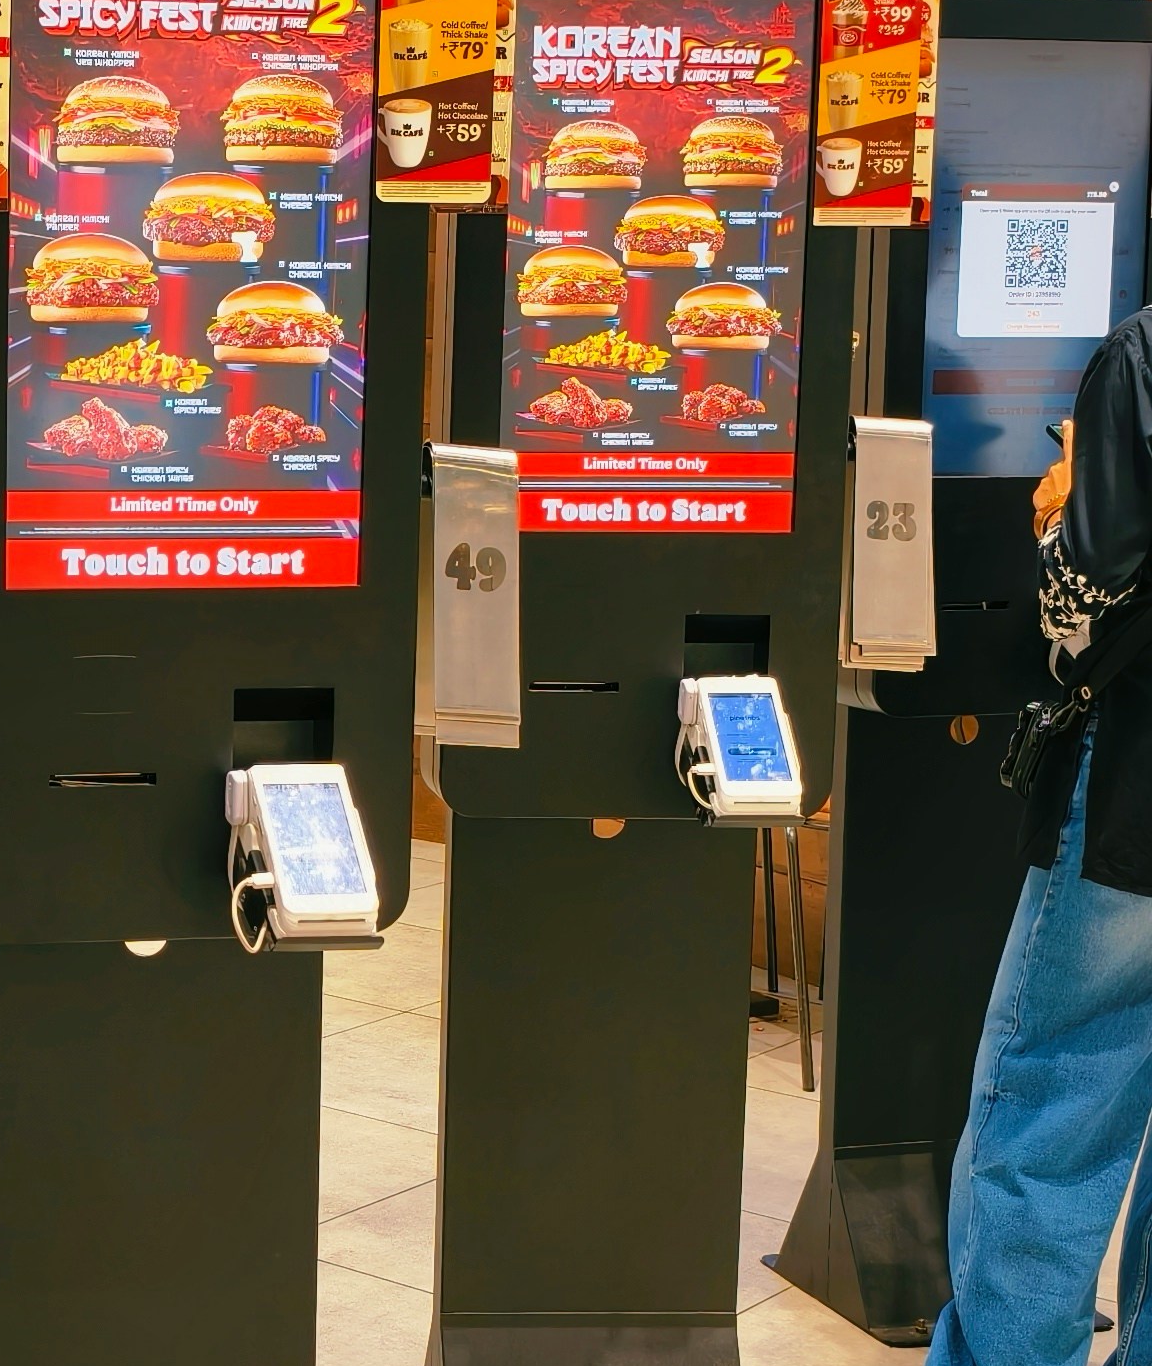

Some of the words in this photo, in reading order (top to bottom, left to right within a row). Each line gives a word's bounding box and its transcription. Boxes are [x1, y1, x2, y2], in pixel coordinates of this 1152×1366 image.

[140, 1, 220, 33] FEST
[221, 14, 278, 33] KIMCHI
[281, 17, 309, 30] FIRE
[533, 25, 681, 58] KOREAN
[533, 58, 613, 84] SPICY
[615, 58, 681, 85] FEST
[110, 496, 172, 513] Limited
[175, 497, 216, 513] Time
[220, 496, 259, 515] Only
[542, 497, 631, 523] Touch
[637, 500, 666, 522] to
[671, 498, 746, 523] Start
[866, 500, 917, 541] 23
[60, 546, 170, 577] Touch
[176, 550, 211, 575] to
[216, 547, 305, 576] Start
[444, 542, 507, 592] 49
